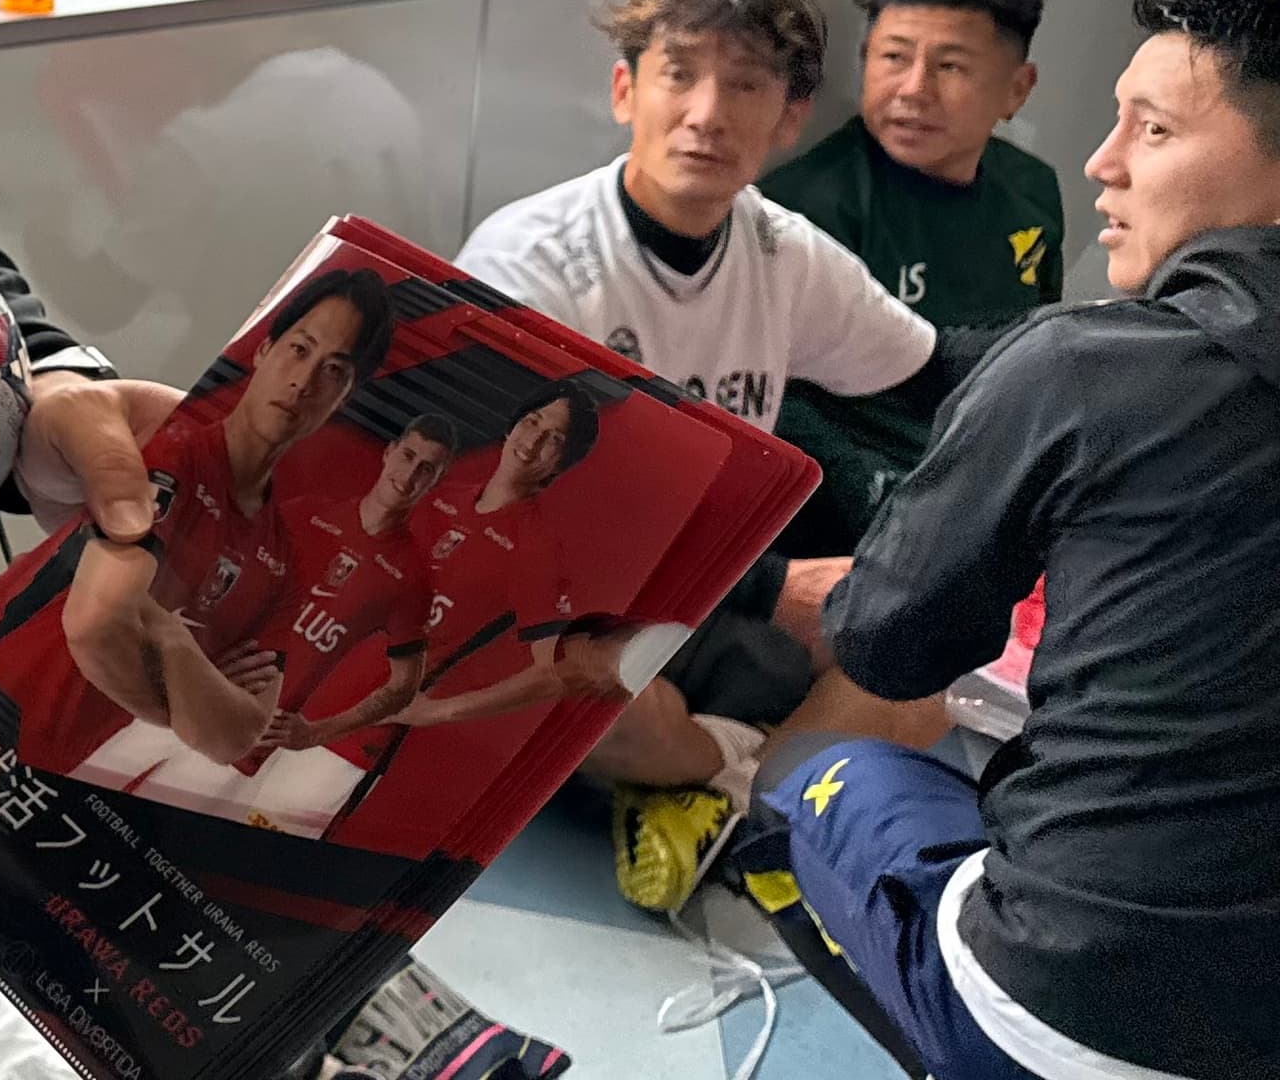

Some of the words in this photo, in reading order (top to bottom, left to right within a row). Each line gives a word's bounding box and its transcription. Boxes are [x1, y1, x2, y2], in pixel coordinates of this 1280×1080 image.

[84, 793, 141, 850] FOOTBALL
[143, 846, 205, 905] TOGETHER
[202, 901, 246, 944] URAWA
[129, 976, 204, 1049] REDS
